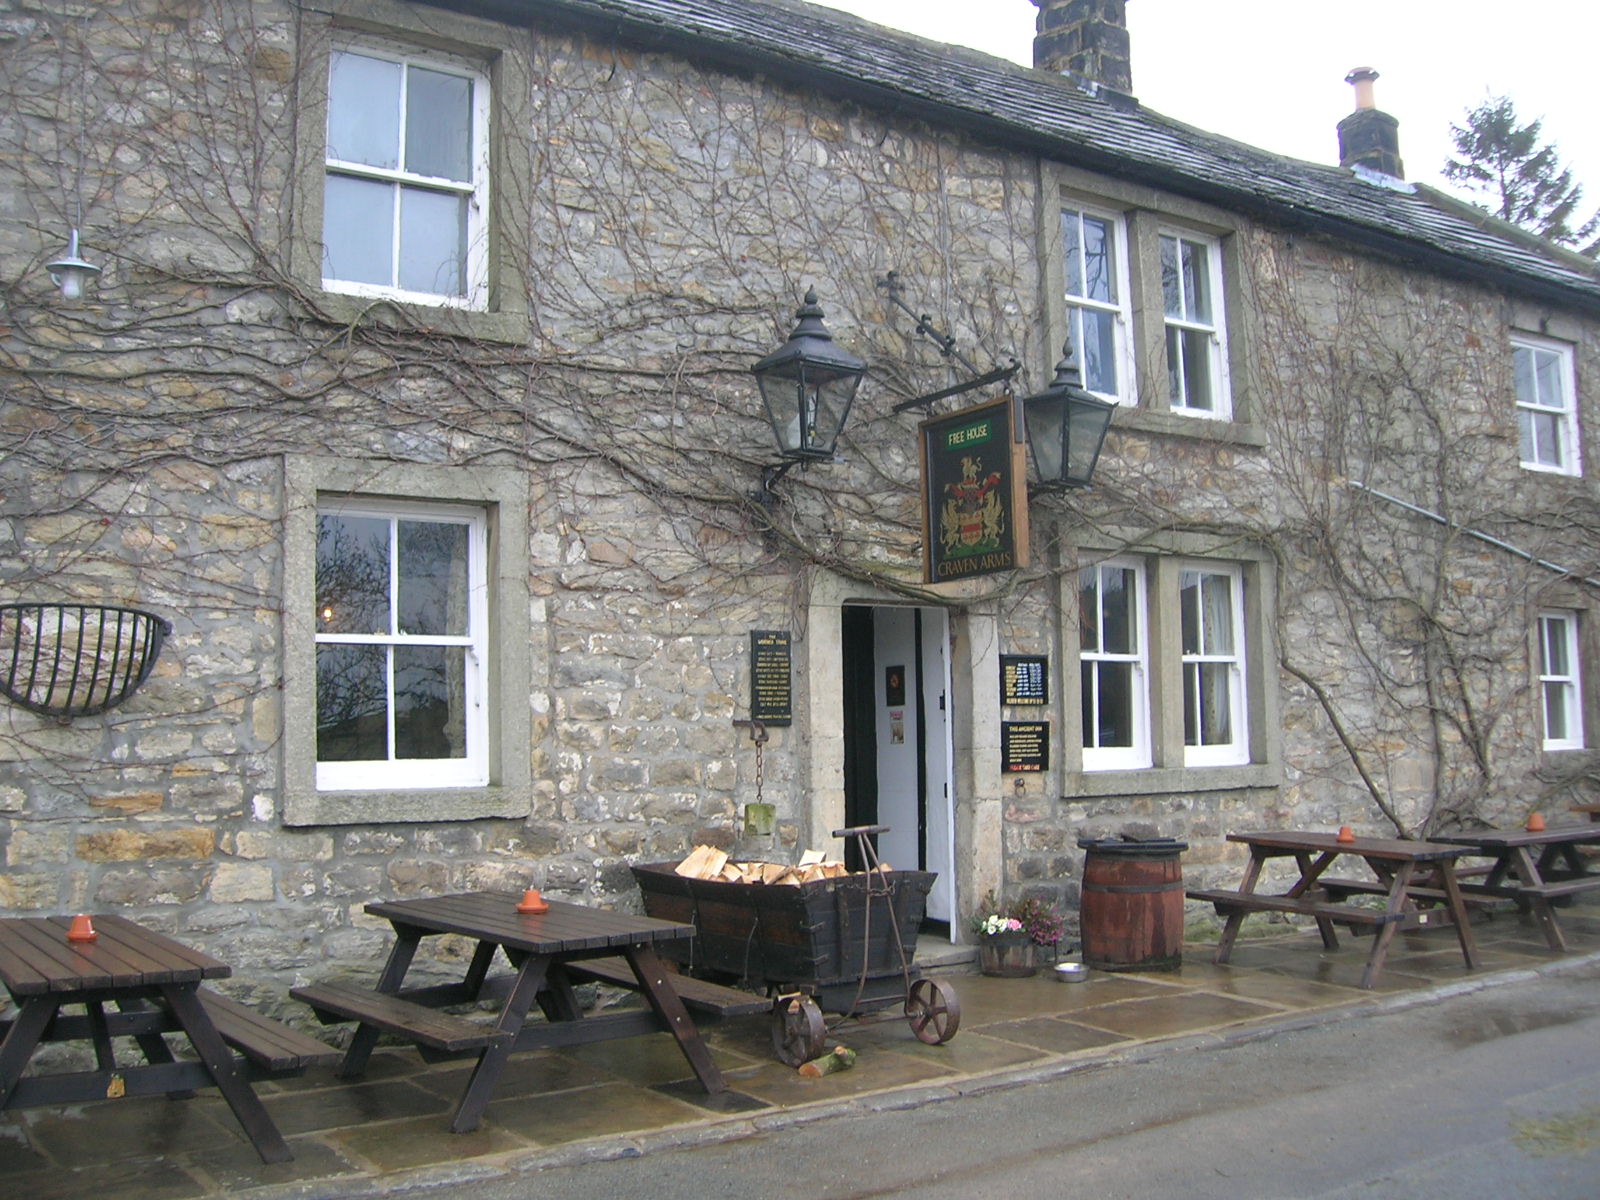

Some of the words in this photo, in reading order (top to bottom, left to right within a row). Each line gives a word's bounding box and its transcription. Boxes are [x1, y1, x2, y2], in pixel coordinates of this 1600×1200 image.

[948, 430, 965, 446] FREE
[966, 424, 988, 441] HOUSE
[937, 559, 978, 577] CRAVEN
[980, 552, 1011, 569] ARMS
